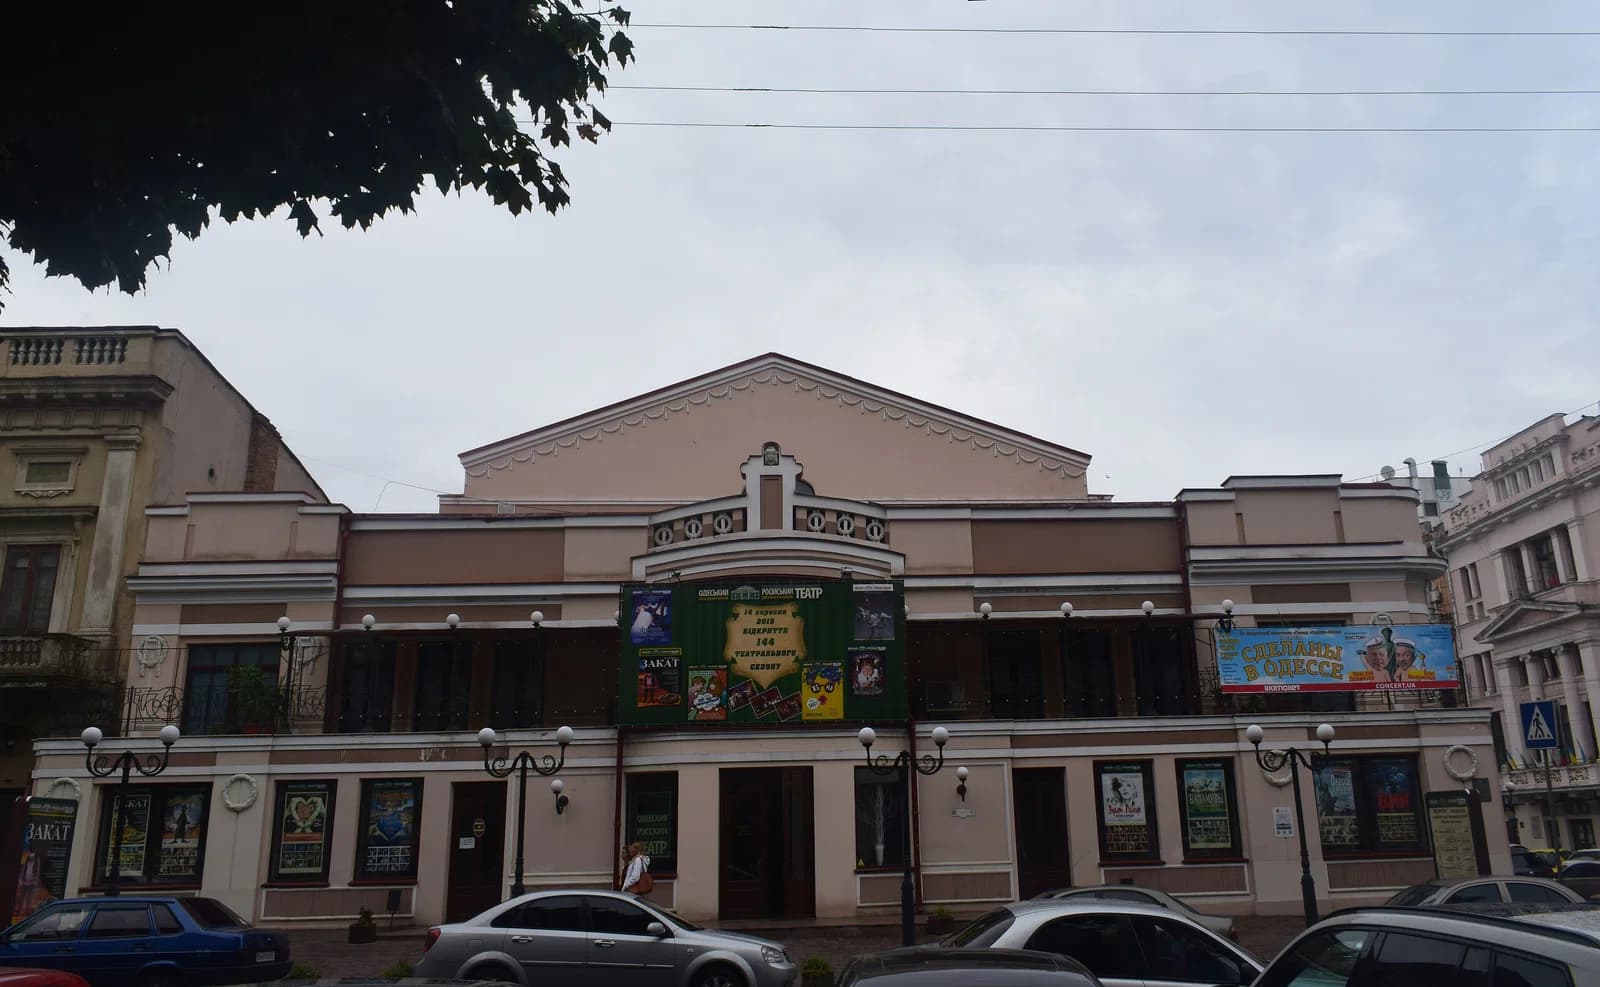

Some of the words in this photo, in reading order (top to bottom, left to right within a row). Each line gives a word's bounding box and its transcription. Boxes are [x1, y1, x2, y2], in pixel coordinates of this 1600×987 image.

[795, 587, 823, 599] ТЕАТР
[756, 638, 775, 646] 144
[1241, 640, 1343, 663] СДЕЛАНЫ
[641, 659, 681, 668] ЗАКАТ
[1243, 664, 1258, 682] В
[1263, 659, 1344, 680] ОДЕССЕ
[27, 823, 71, 841] ЗАКАТ
